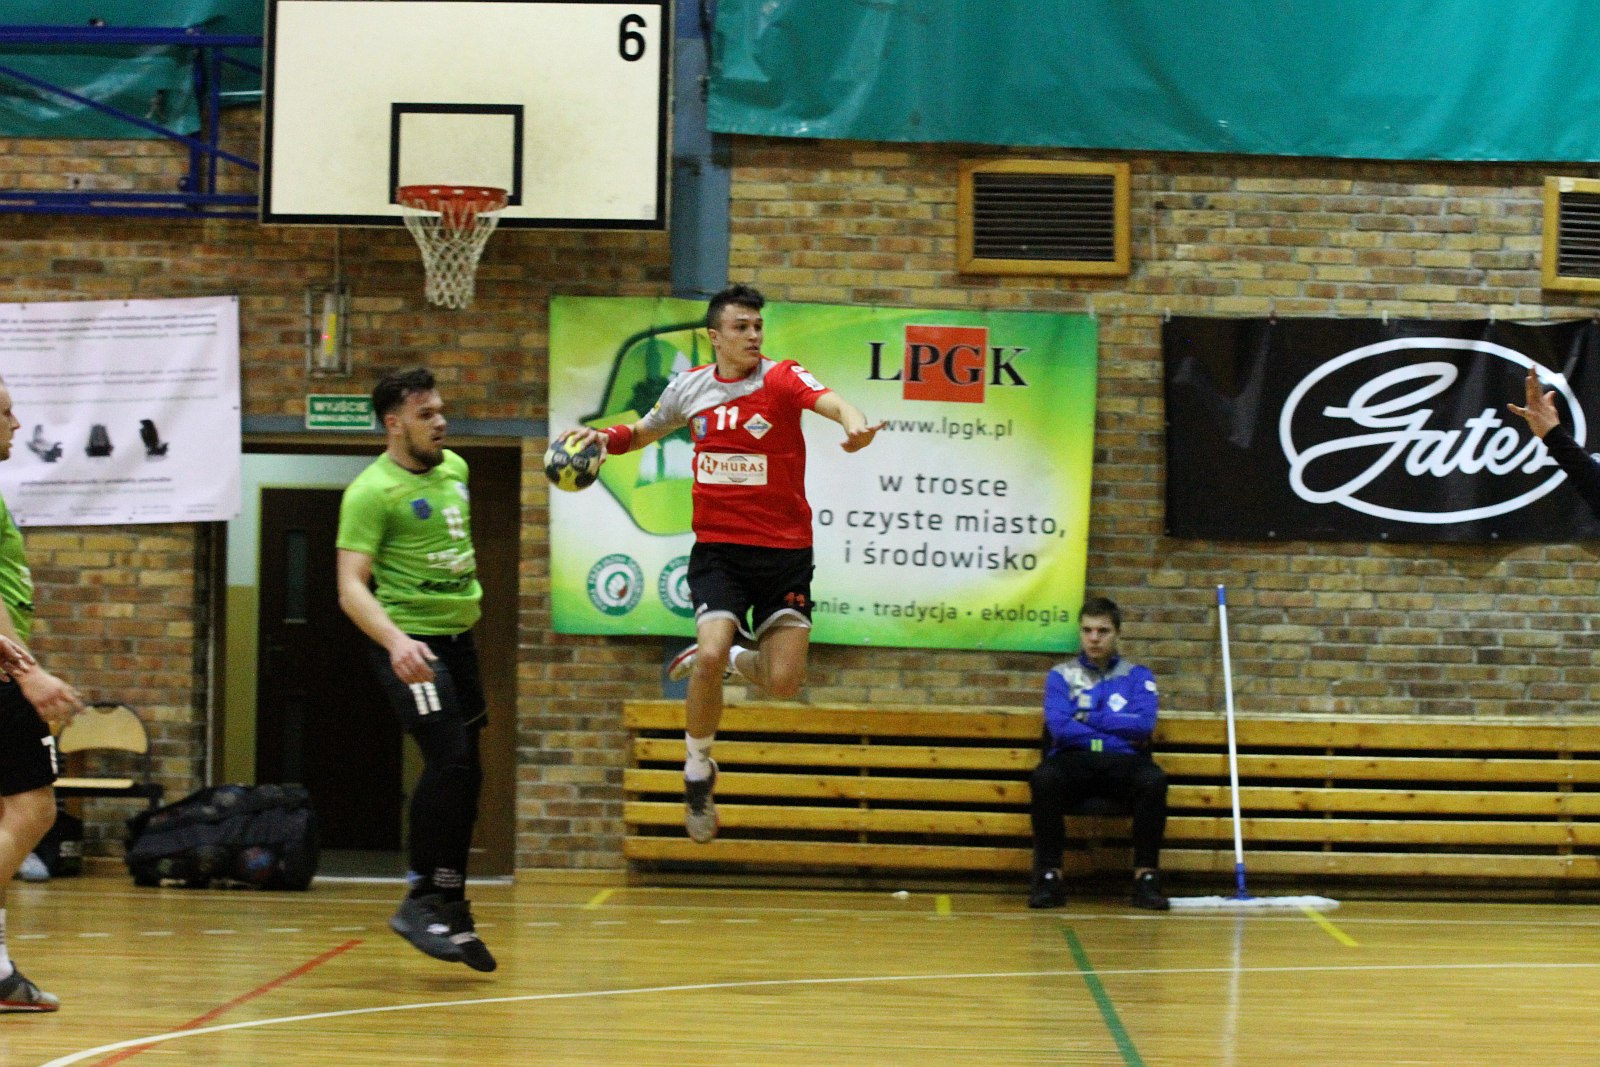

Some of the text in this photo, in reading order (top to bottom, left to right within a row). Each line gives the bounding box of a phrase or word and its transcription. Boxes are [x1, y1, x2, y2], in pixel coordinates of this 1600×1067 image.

[618, 14, 647, 61] 6
[866, 342, 1028, 387] LPGK
[713, 405, 739, 430] 11
[1290, 361, 1559, 504] Gates
[721, 462, 764, 472] HURAS
[879, 472, 1008, 497] w trosce
[818, 508, 1066, 538] o czyste miasto,
[844, 540, 1037, 571] i środowisko
[873, 600, 957, 623] tradycja
[981, 603, 1069, 627] ekologia
